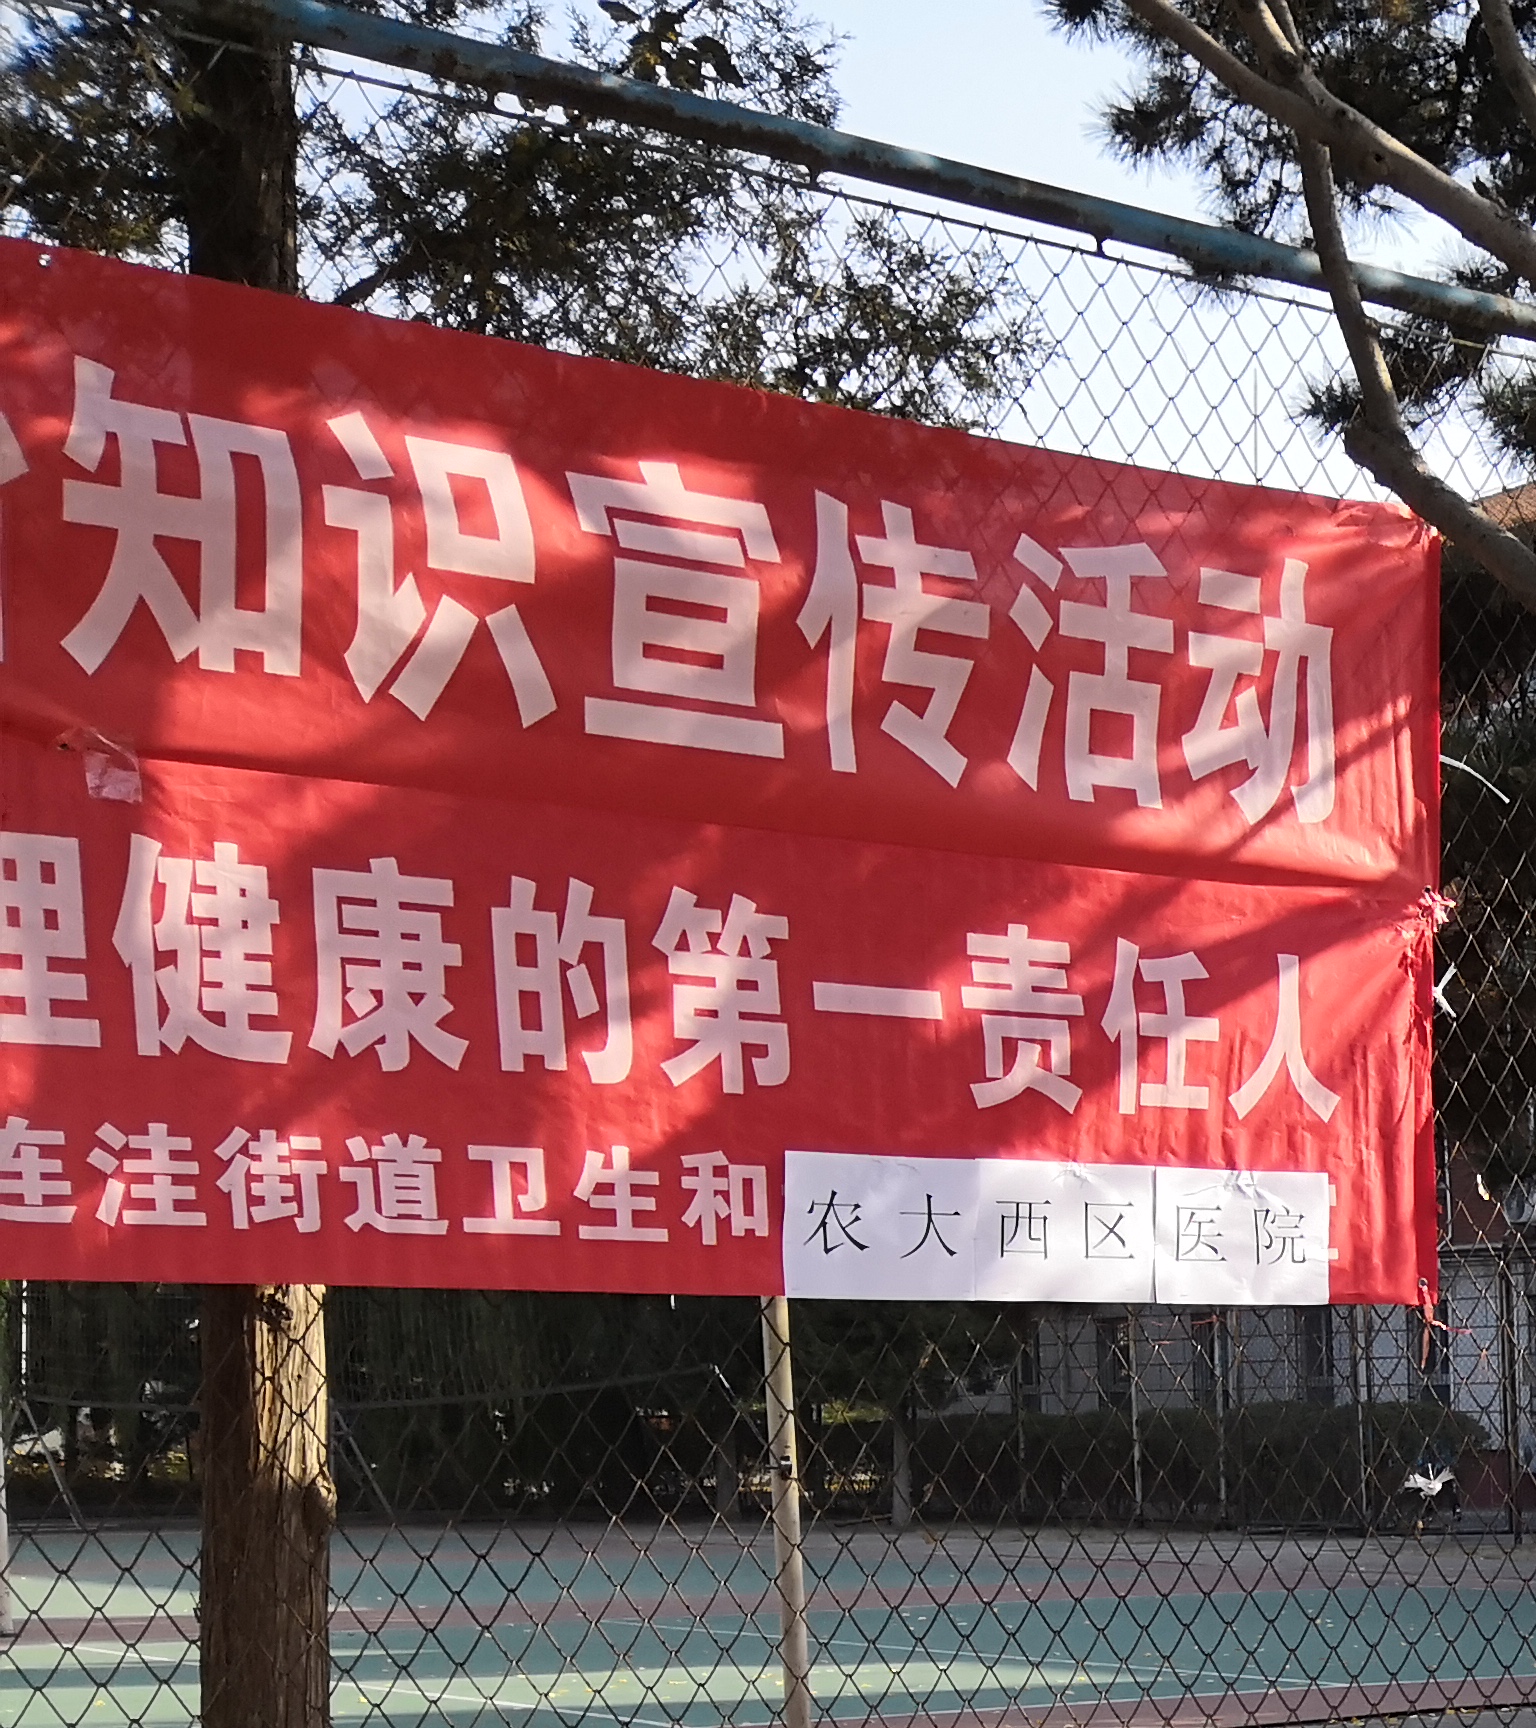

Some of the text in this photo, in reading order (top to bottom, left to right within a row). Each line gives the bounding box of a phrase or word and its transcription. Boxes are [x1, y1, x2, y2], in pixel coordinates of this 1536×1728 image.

[0, 355, 1335, 826] 知识宣传活动
[804, 1188, 1308, 1265] 农大西区医院
